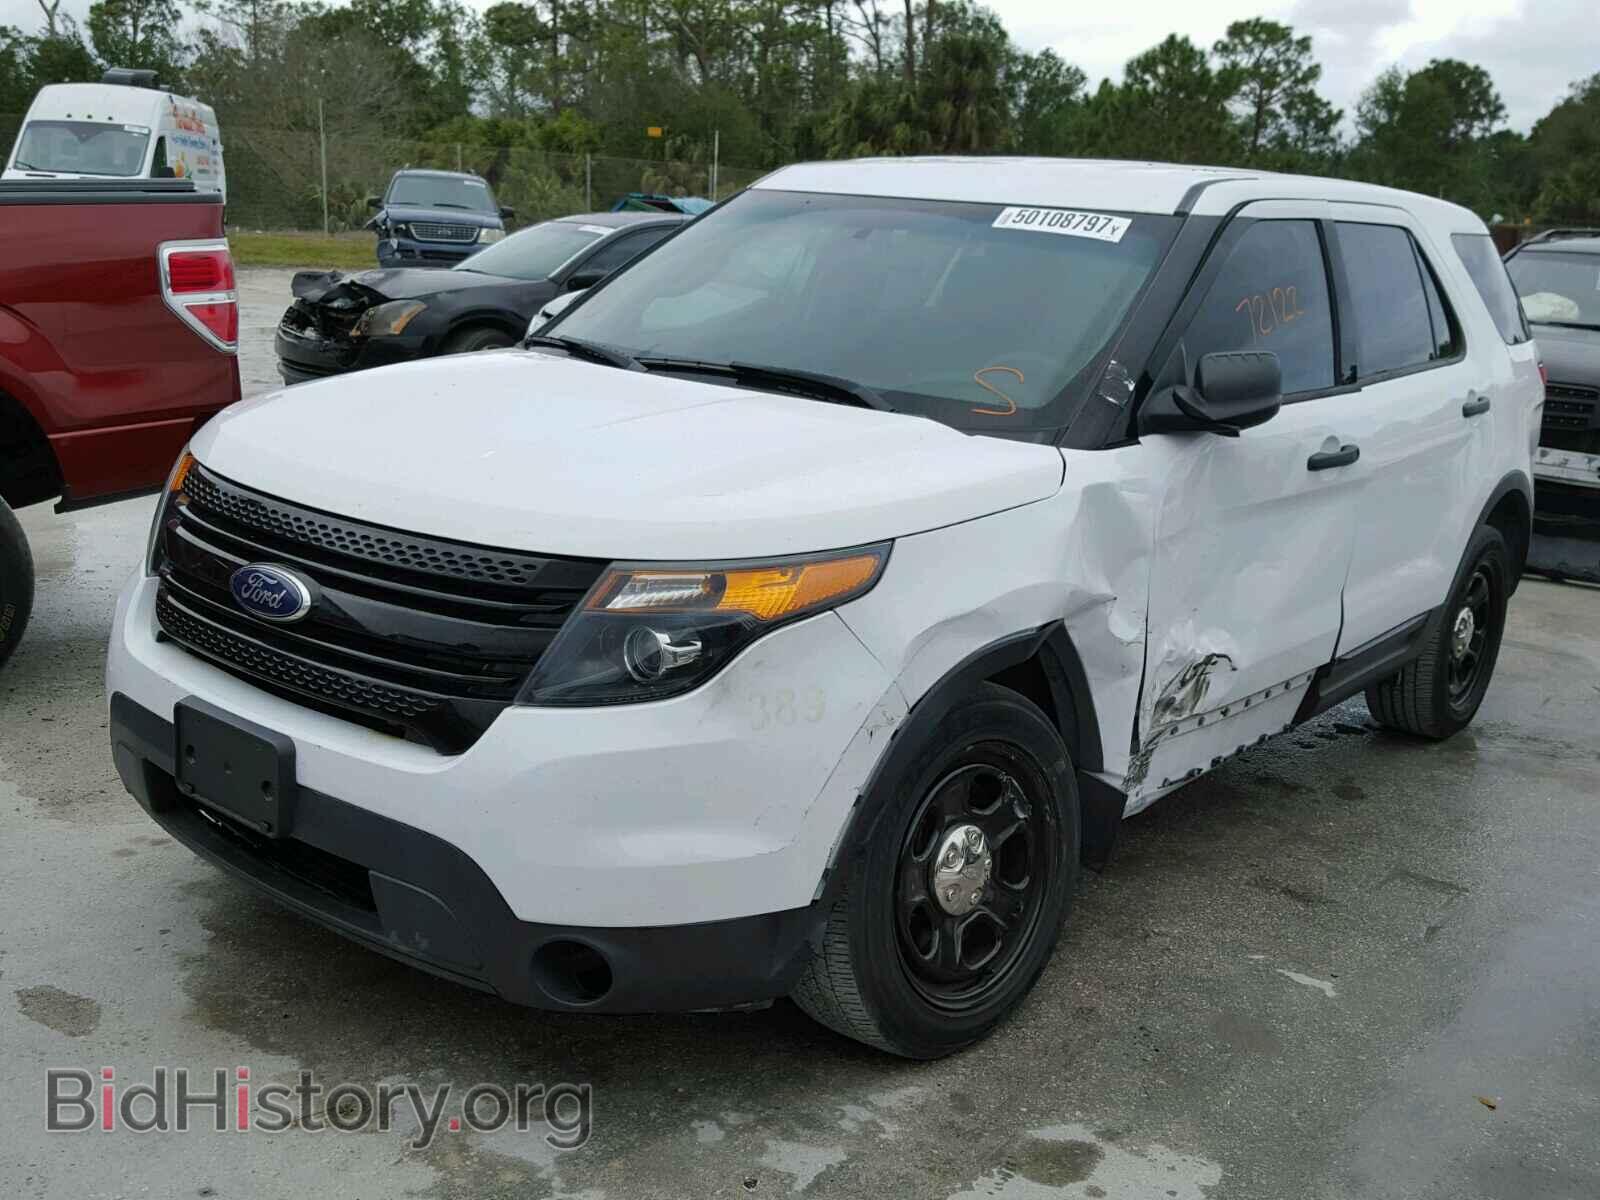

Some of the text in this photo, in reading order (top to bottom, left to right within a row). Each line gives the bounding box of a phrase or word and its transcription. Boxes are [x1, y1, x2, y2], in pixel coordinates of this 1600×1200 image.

[1011, 208, 1114, 234] 50108797
[969, 365, 1025, 416] S
[240, 572, 288, 609] Ford
